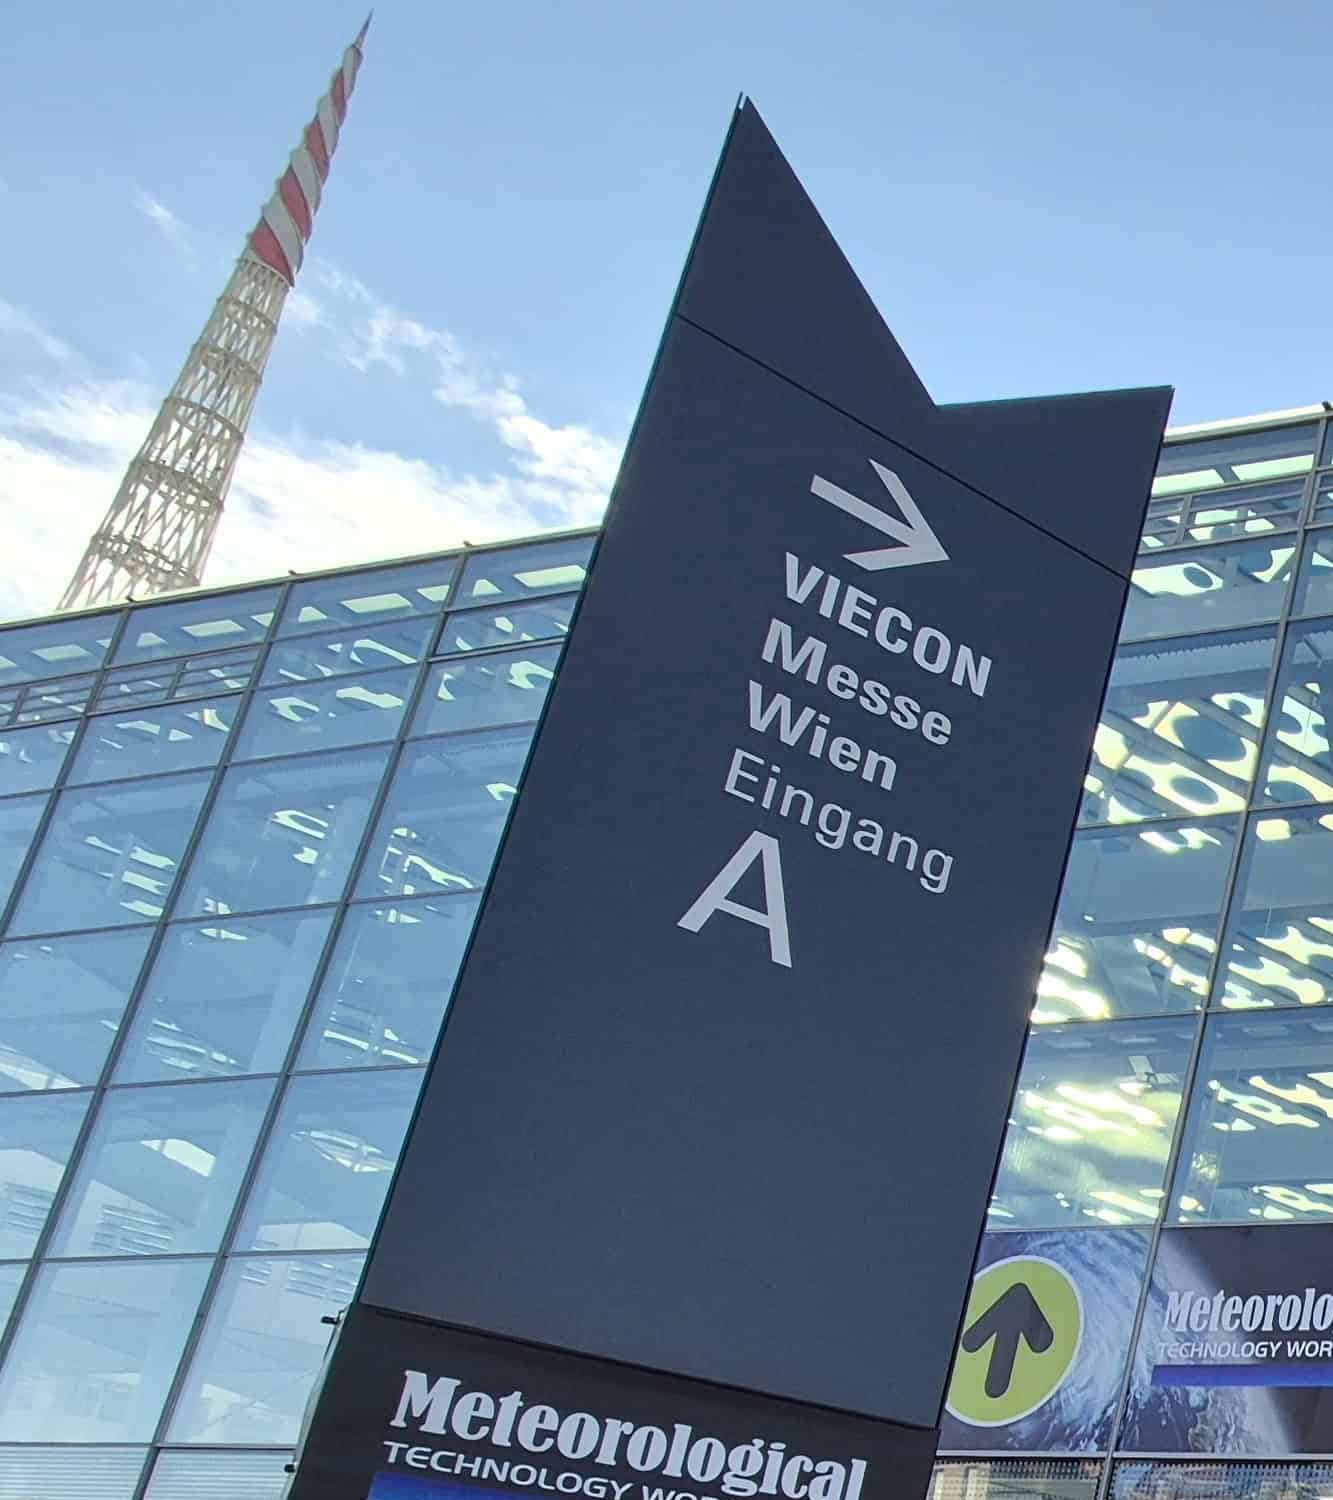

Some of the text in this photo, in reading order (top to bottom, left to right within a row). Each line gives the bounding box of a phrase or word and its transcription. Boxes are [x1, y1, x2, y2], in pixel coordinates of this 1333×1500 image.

[761, 617, 952, 746] Messe
[785, 551, 992, 697] VIECON
[748, 679, 898, 791] Wien
[724, 748, 954, 894] Eingang
[677, 830, 792, 968] A
[1157, 1341, 1283, 1359] TECHNOLOGY
